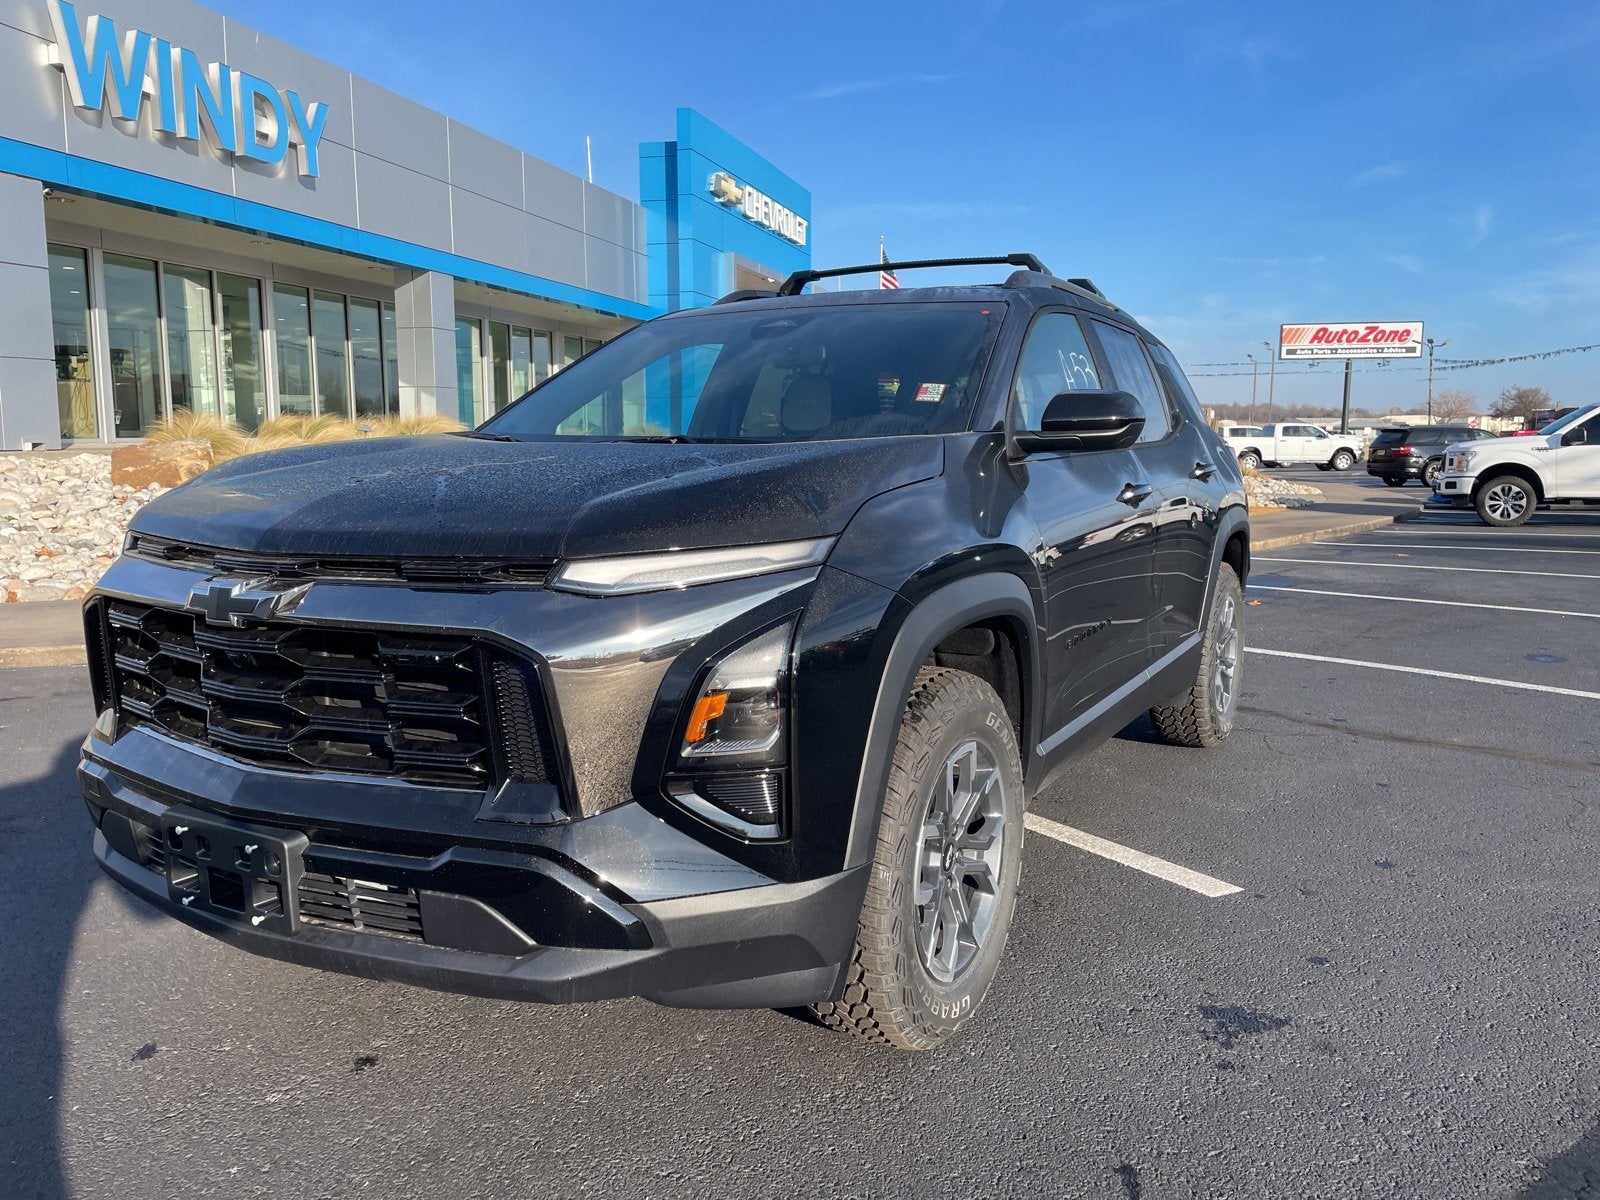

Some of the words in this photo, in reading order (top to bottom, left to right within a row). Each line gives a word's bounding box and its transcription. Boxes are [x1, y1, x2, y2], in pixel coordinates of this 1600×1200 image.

[47, 0, 330, 178] WINDY
[743, 184, 809, 246] CHEVROLET
[1309, 325, 1412, 344] AutoZone
